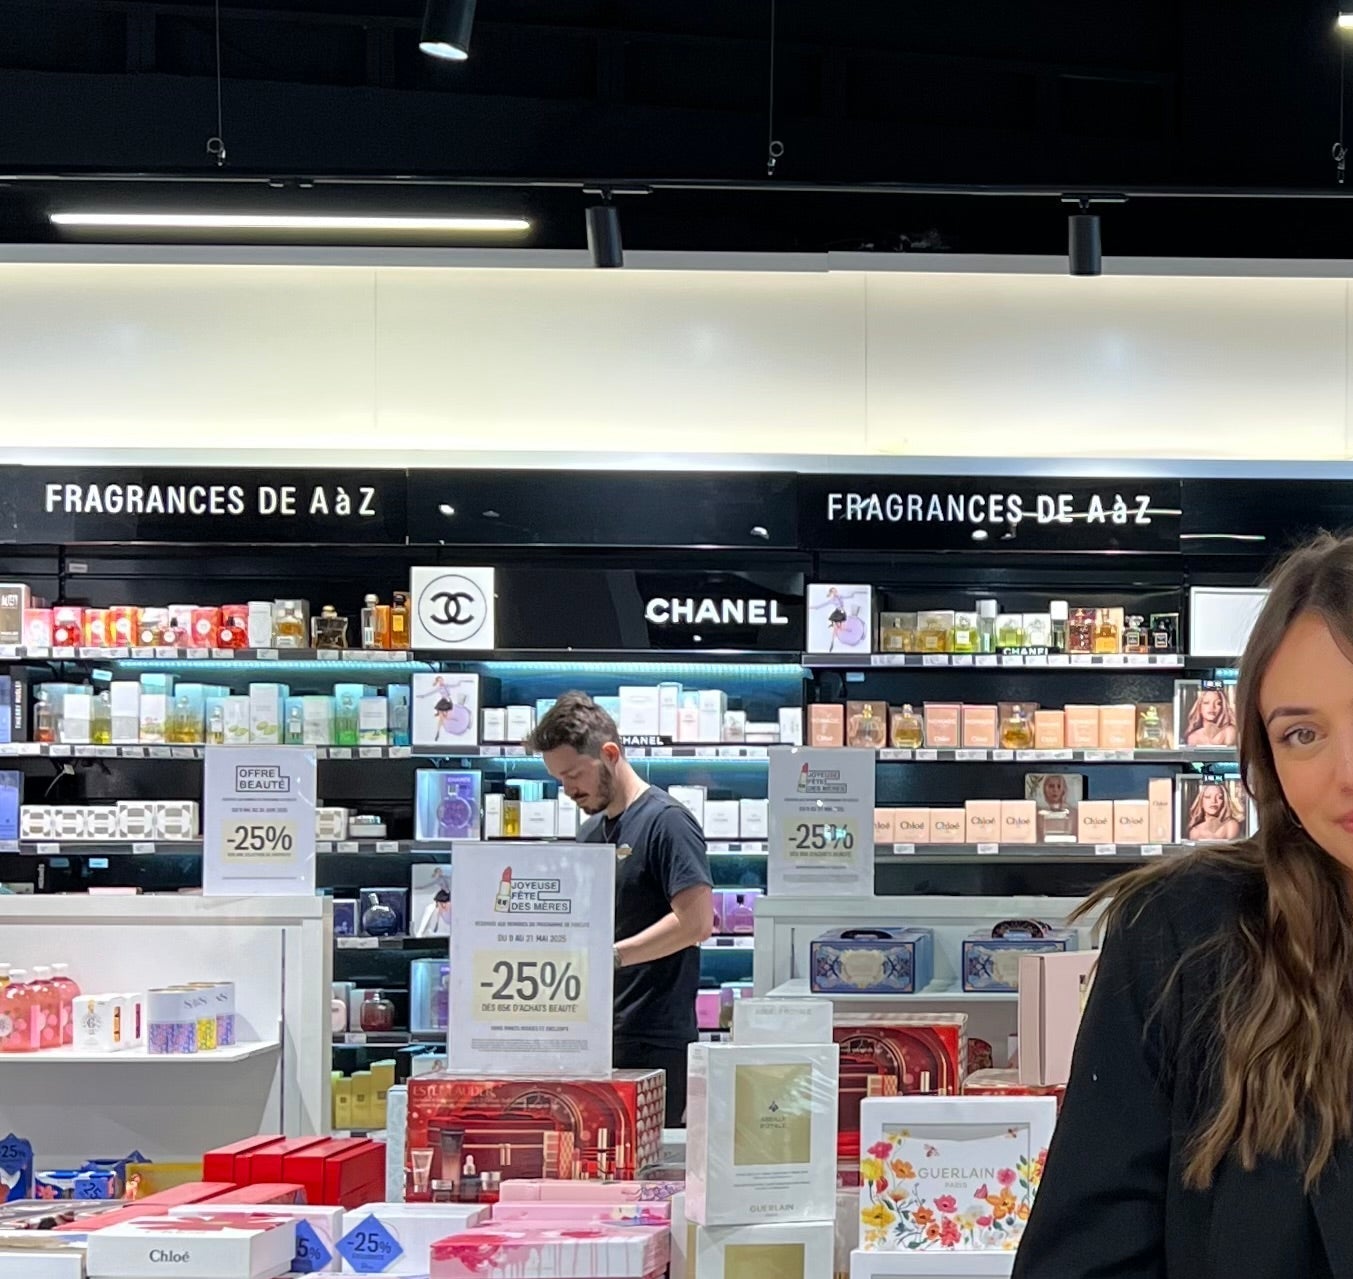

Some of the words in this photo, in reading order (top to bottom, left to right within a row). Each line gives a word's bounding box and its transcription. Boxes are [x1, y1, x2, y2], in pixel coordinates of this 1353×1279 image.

[46, 484, 245, 515] FRAGRANCES
[258, 486, 296, 515] DE
[827, 493, 1023, 522] FRAGRANCES
[1036, 495, 1074, 524] DE
[645, 598, 789, 624] CHANEL
[239, 768, 276, 778] OFFRE
[239, 779, 285, 789] BEAUTÉ
[900, 820, 924, 830] Chloé
[935, 820, 960, 830] Chloé
[971, 816, 995, 825] Chloé
[1083, 816, 1108, 825] Chloé
[1119, 816, 1144, 825] Chloé
[227, 825, 292, 851] -25%
[788, 823, 853, 850] -25%
[511, 881, 557, 890] JOYEUSE
[511, 891, 536, 900] FÊTE
[511, 902, 531, 911] DES
[534, 901, 568, 911] MÈRES
[497, 935, 507, 943] DU
[515, 935, 524, 943] AU
[526, 935, 534, 943] 21
[536, 935, 549, 943] MAI
[550, 935, 567, 943] 2025
[480, 960, 581, 1001] -25%
[512, 1004, 547, 1012] D'ACHATS
[918, 1167, 995, 1179] GUERLAIN
[750, 1203, 794, 1213] GUERLAIN
[347, 1231, 392, 1254] -25%
[149, 1248, 190, 1263] Chloé
